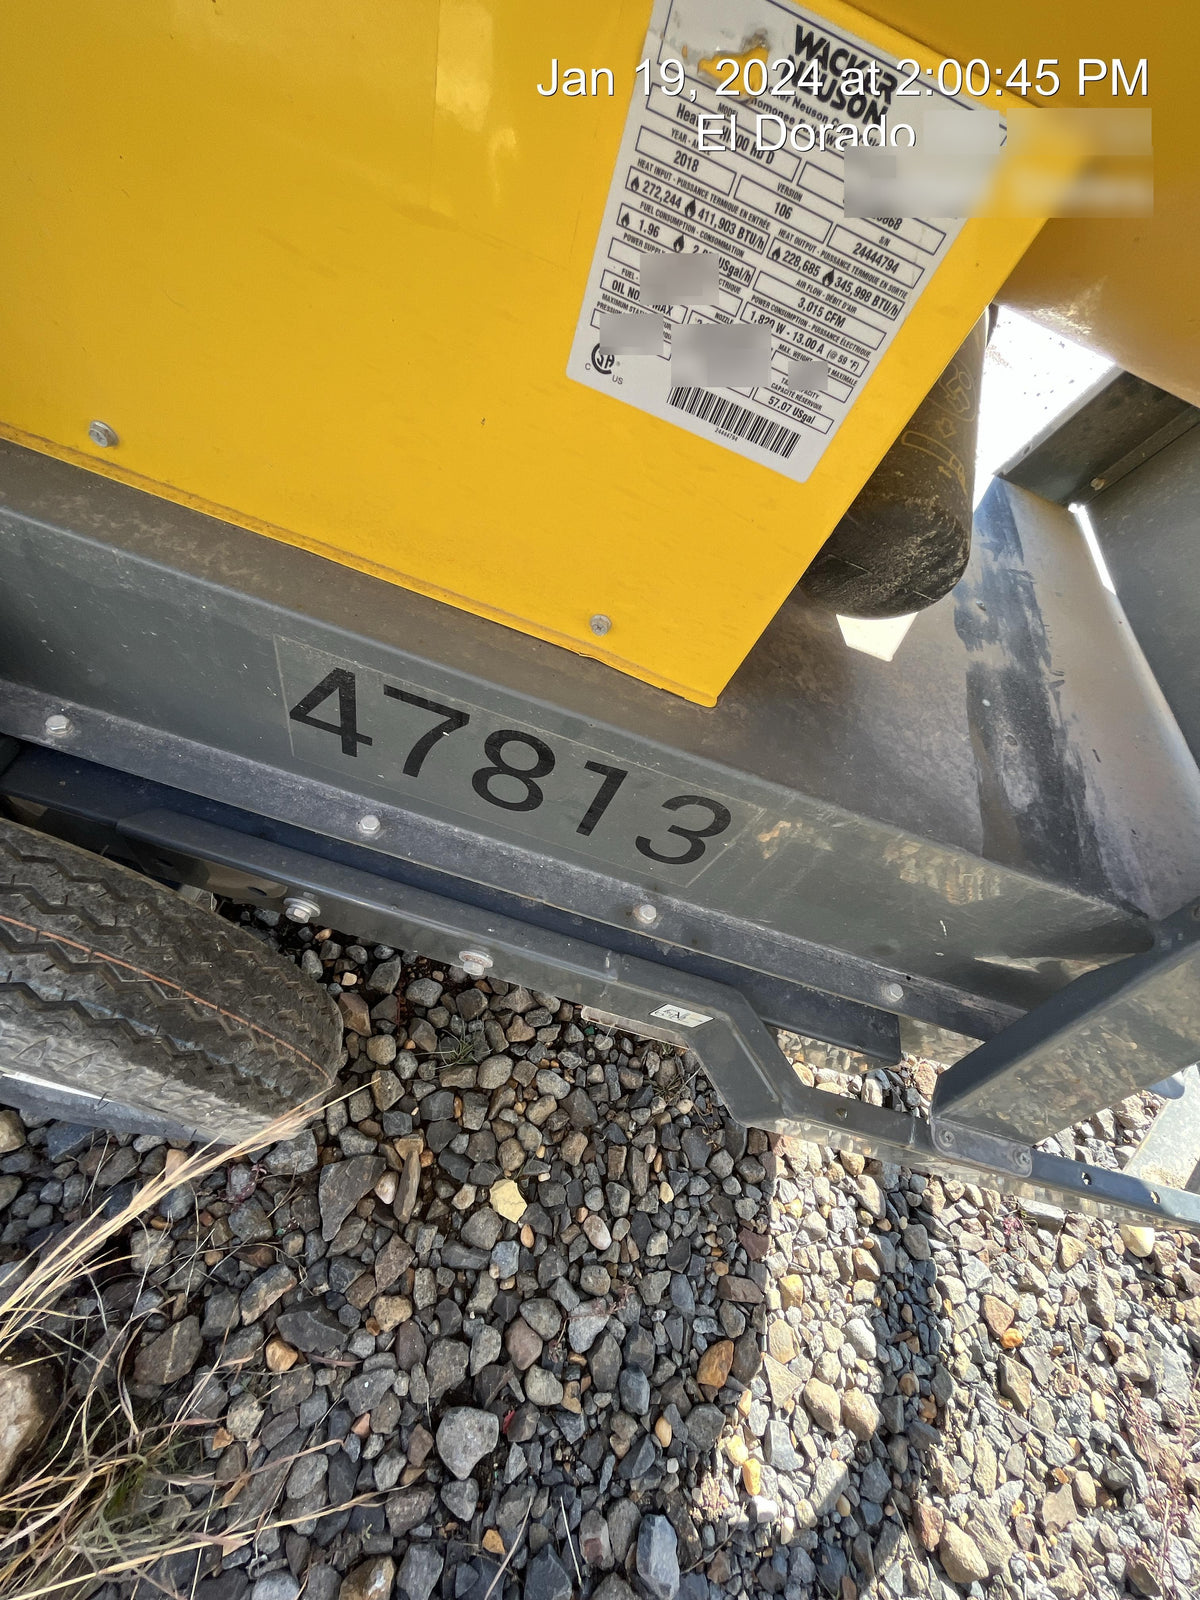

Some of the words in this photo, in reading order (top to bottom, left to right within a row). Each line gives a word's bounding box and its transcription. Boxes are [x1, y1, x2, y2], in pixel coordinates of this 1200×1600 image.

[795, 24, 897, 103] WACKER
[780, 54, 889, 127] NEUSON
[792, 96, 829, 123] Neuson
[671, 128, 687, 143] YEAR
[673, 150, 699, 173] 2018
[637, 158, 654, 172] HEAT
[654, 166, 672, 181] INPUT
[676, 177, 709, 199] PUISSANCE
[710, 193, 739, 214] TERMIQUE
[739, 209, 748, 219] EN
[748, 213, 770, 230] ENTRÉE
[777, 182, 803, 202] VERSION
[642, 180, 682, 209] 272,244
[698, 208, 737, 235] 411,903
[737, 226, 764, 250] BTU/h
[774, 202, 793, 220] 106
[623, 232, 643, 247] POWER
[639, 219, 660, 238] 1.96
[640, 201, 654, 215] FUEL
[655, 209, 696, 234] CONSUMPTION
[700, 230, 744, 258] CONSOMMATION
[879, 236, 891, 247] S/N
[778, 228, 794, 242] HEAT
[794, 237, 817, 253] OUTPUT
[851, 266, 880, 285] TERMIQUE
[879, 280, 888, 289] EN
[887, 284, 908, 299] SORTIE
[852, 242, 900, 274] 24444794
[612, 280, 624, 295] OIL
[621, 268, 634, 280] FUEL
[782, 250, 821, 277] 228,685
[834, 276, 872, 302] 345,998
[871, 295, 898, 316] BTU/h
[602, 293, 629, 310] MAXIMUM
[796, 279, 807, 289] AIR
[806, 284, 823, 297] FLOW
[825, 293, 842, 307] DÉBIT
[841, 301, 857, 314] D'AIR
[751, 295, 771, 309] POWER
[770, 304, 808, 327] CONSUMPTION
[798, 297, 825, 317] 3,015
[824, 310, 846, 328] CFM
[776, 322, 786, 334] W
[792, 332, 817, 350] 13.00
[816, 344, 825, 354] A
[837, 355, 848, 365] 59
[612, 375, 623, 384] US
[831, 369, 858, 386] MAXIMALE
[768, 397, 792, 413] 57.07
[793, 407, 816, 425] USgal
[289, 667, 731, 865] 47813
